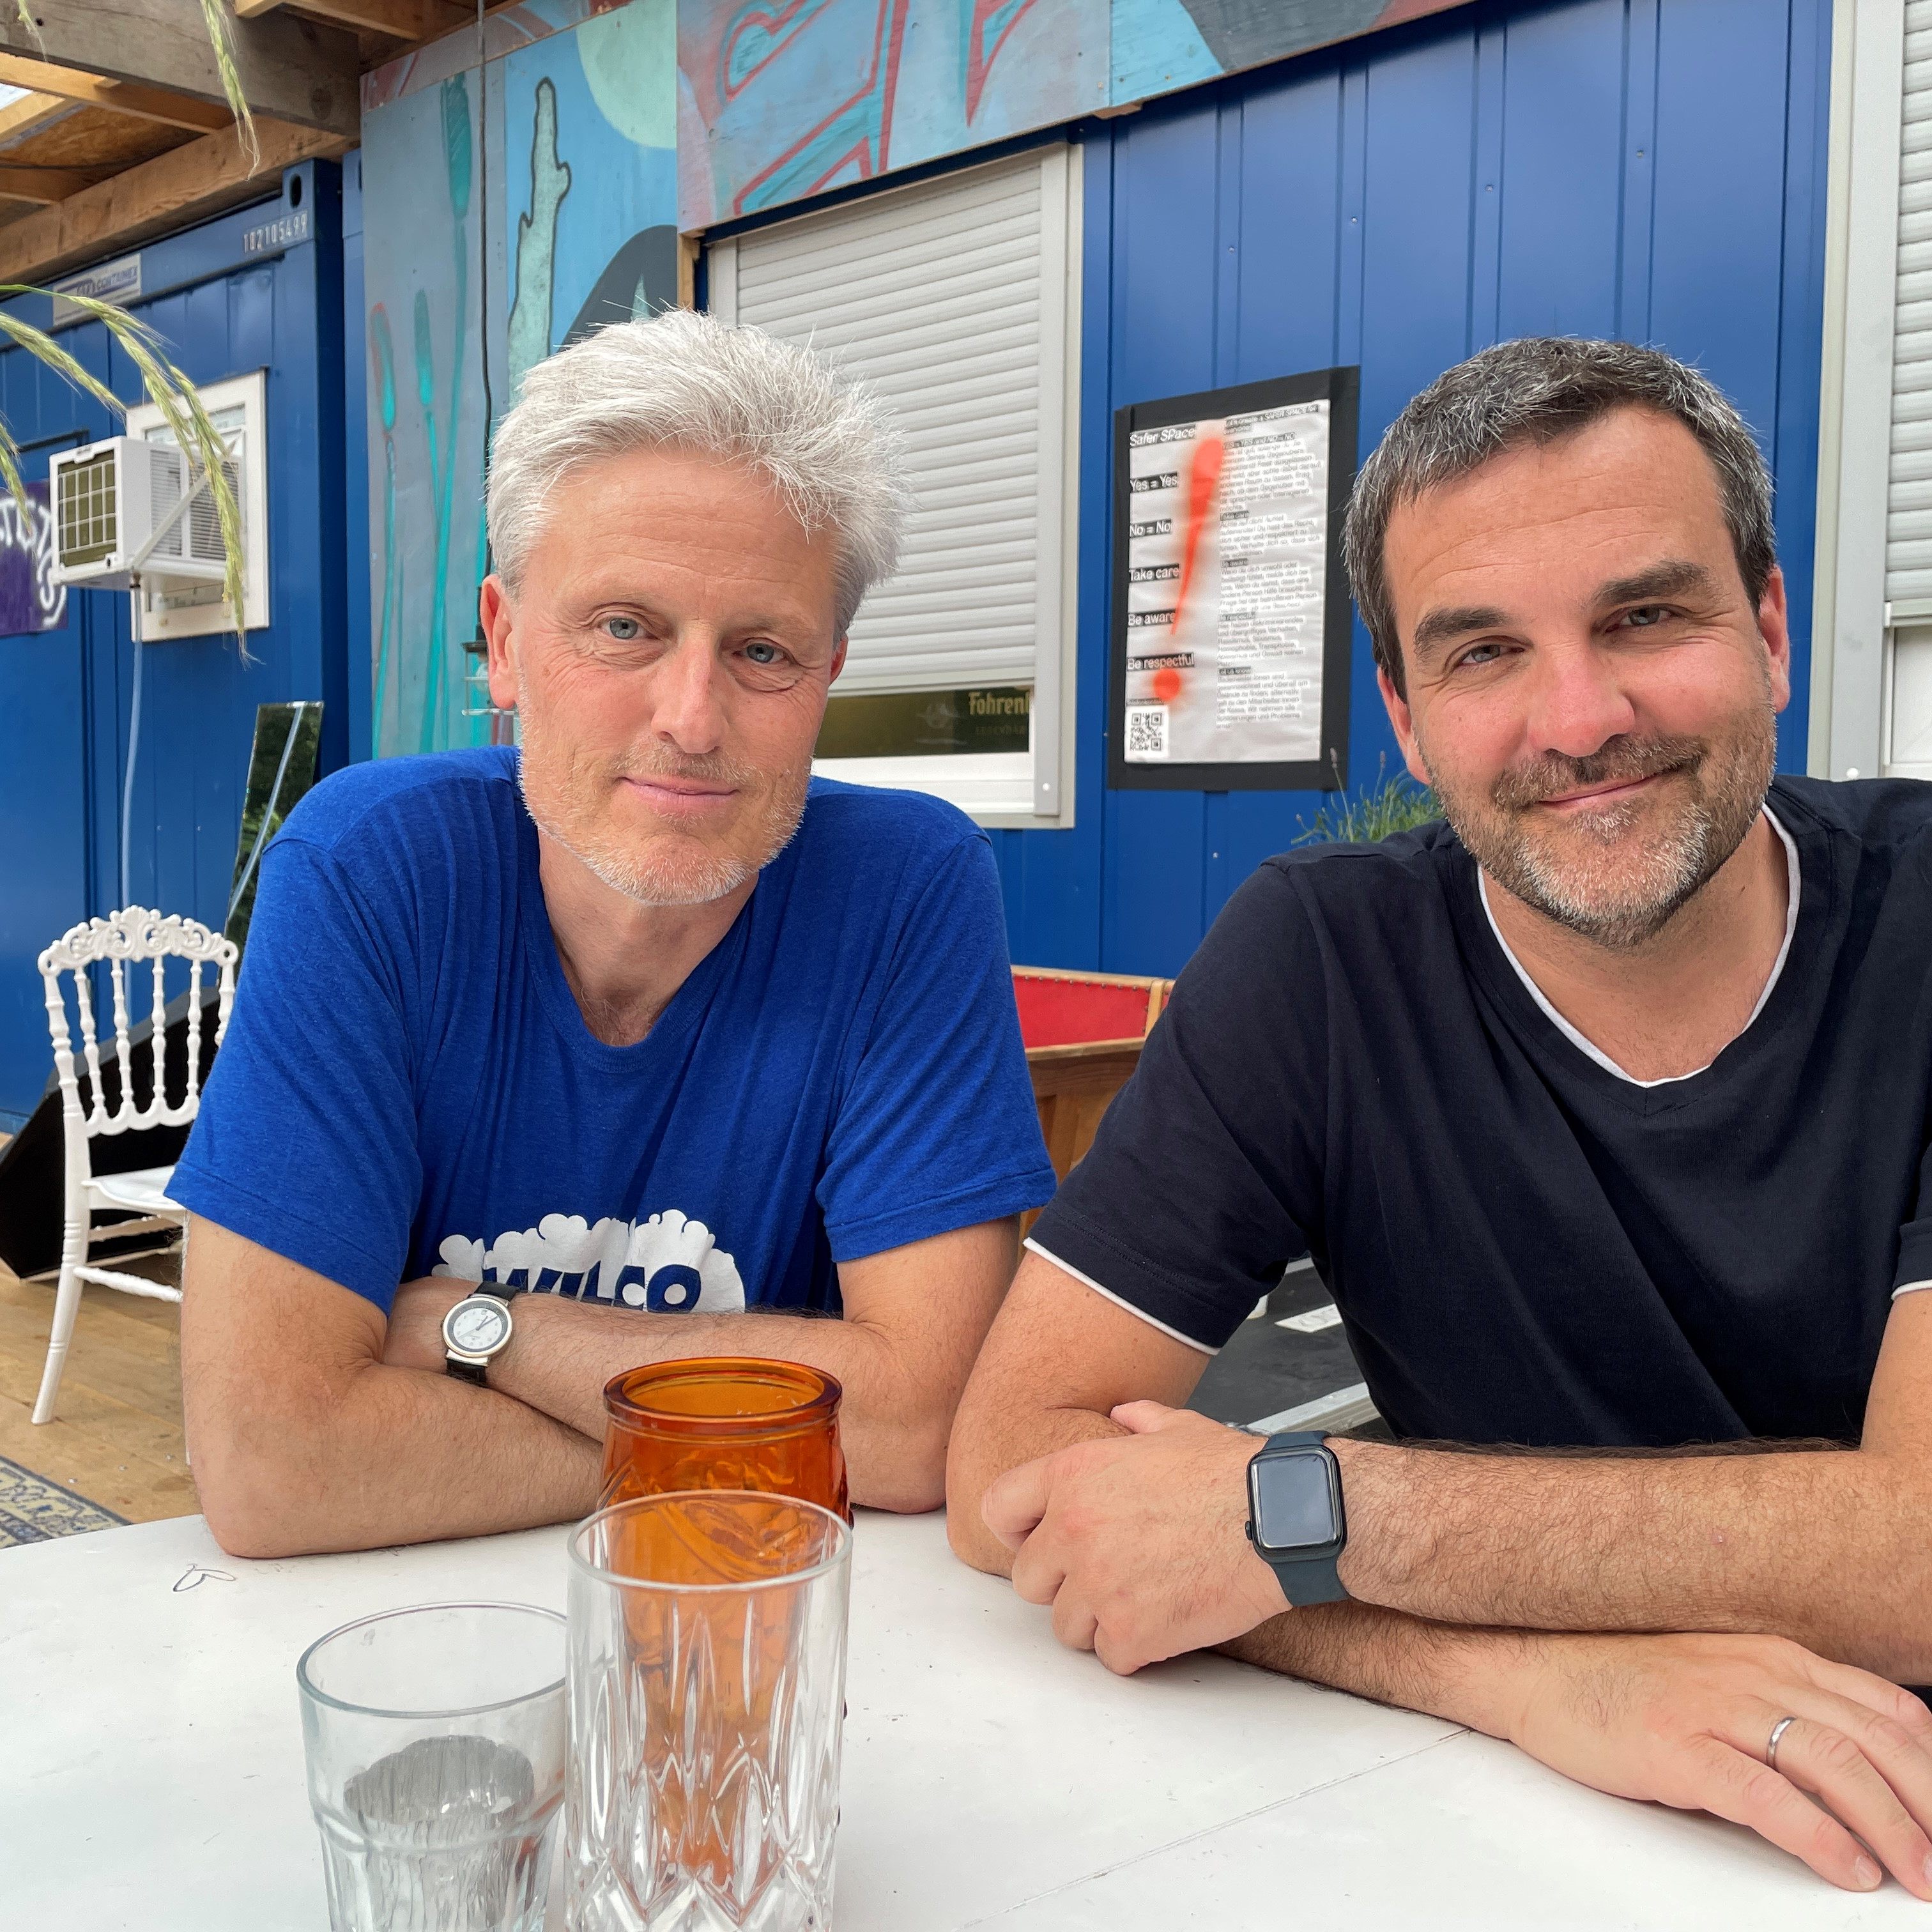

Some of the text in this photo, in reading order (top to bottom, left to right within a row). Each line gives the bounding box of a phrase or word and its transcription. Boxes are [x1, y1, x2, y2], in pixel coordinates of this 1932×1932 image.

[1130, 428, 1195, 447] Safer SPace
[1130, 479, 1148, 491] Yes
[1160, 474, 1177, 487] Yes
[1130, 525, 1144, 537] No
[1156, 520, 1171, 533] No
[1129, 567, 1179, 581] Take care
[1128, 614, 1142, 625] Be
[1128, 652, 1194, 670] Be respectful
